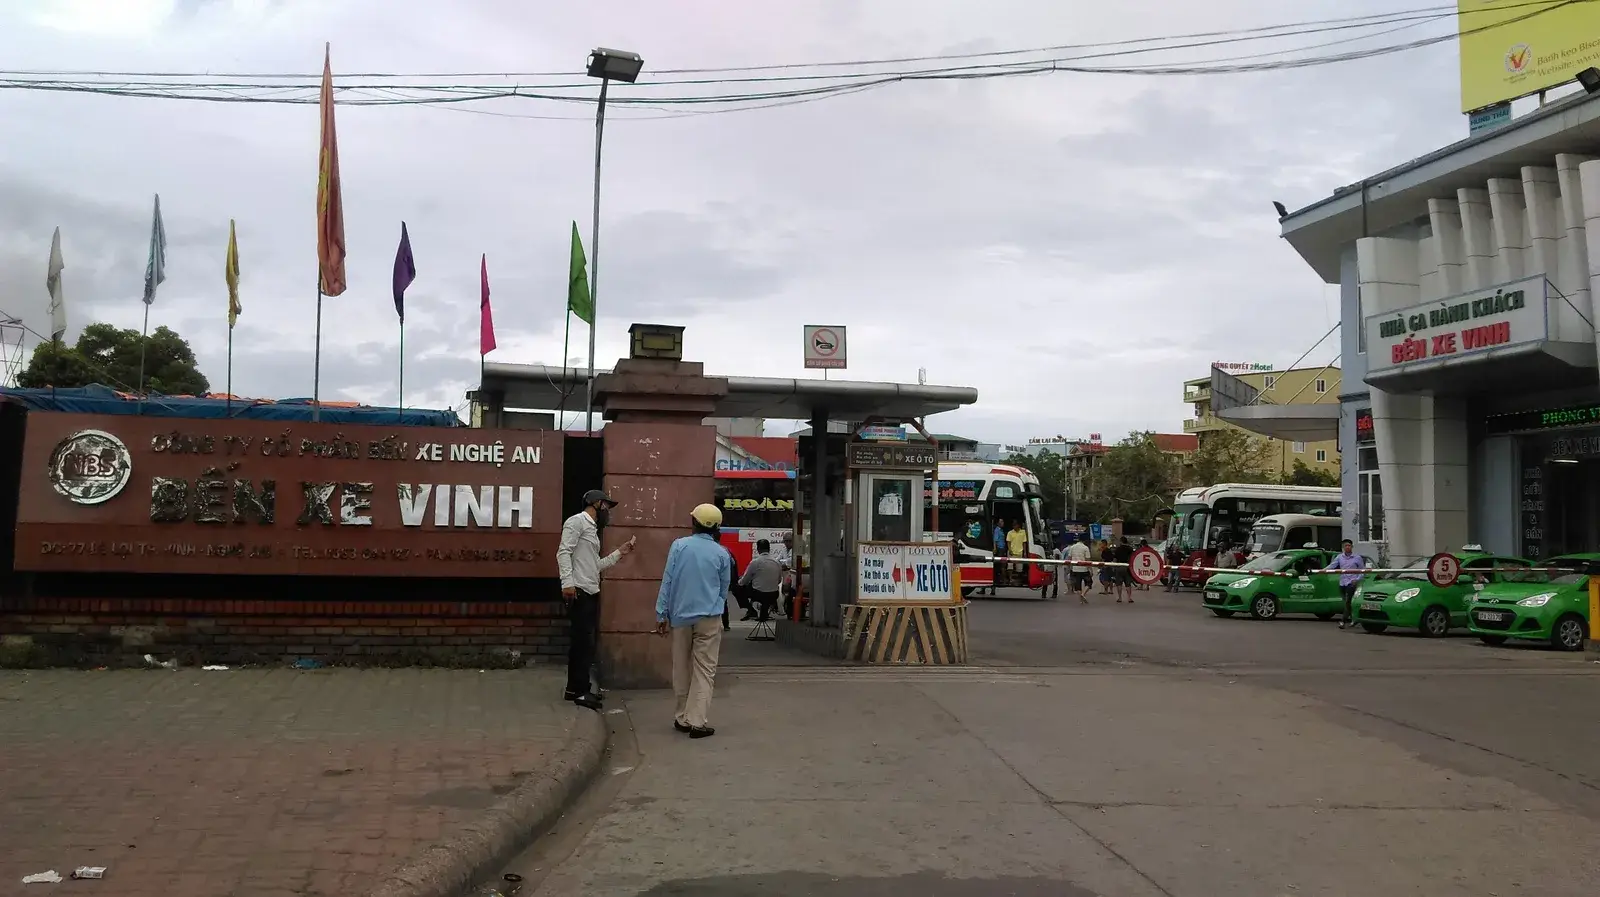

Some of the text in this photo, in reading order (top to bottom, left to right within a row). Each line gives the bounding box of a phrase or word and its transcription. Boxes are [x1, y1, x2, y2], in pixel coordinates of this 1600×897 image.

[1379, 289, 1526, 339] NHÀ GA HÀNH KHÁCH
[1391, 321, 1511, 364] BẾN XE VINH
[415, 443, 443, 461] XE
[450, 440, 505, 467] NGHỆ
[511, 445, 541, 464] AN
[905, 455, 915, 463] XE
[150, 461, 533, 528] BẾN XE VINH
[863, 557, 884, 568] Xe máy
[1142, 554, 1151, 567] 5
[1442, 559, 1450, 572] 5
[863, 571, 872, 580] Xe
[916, 563, 929, 592] XE
